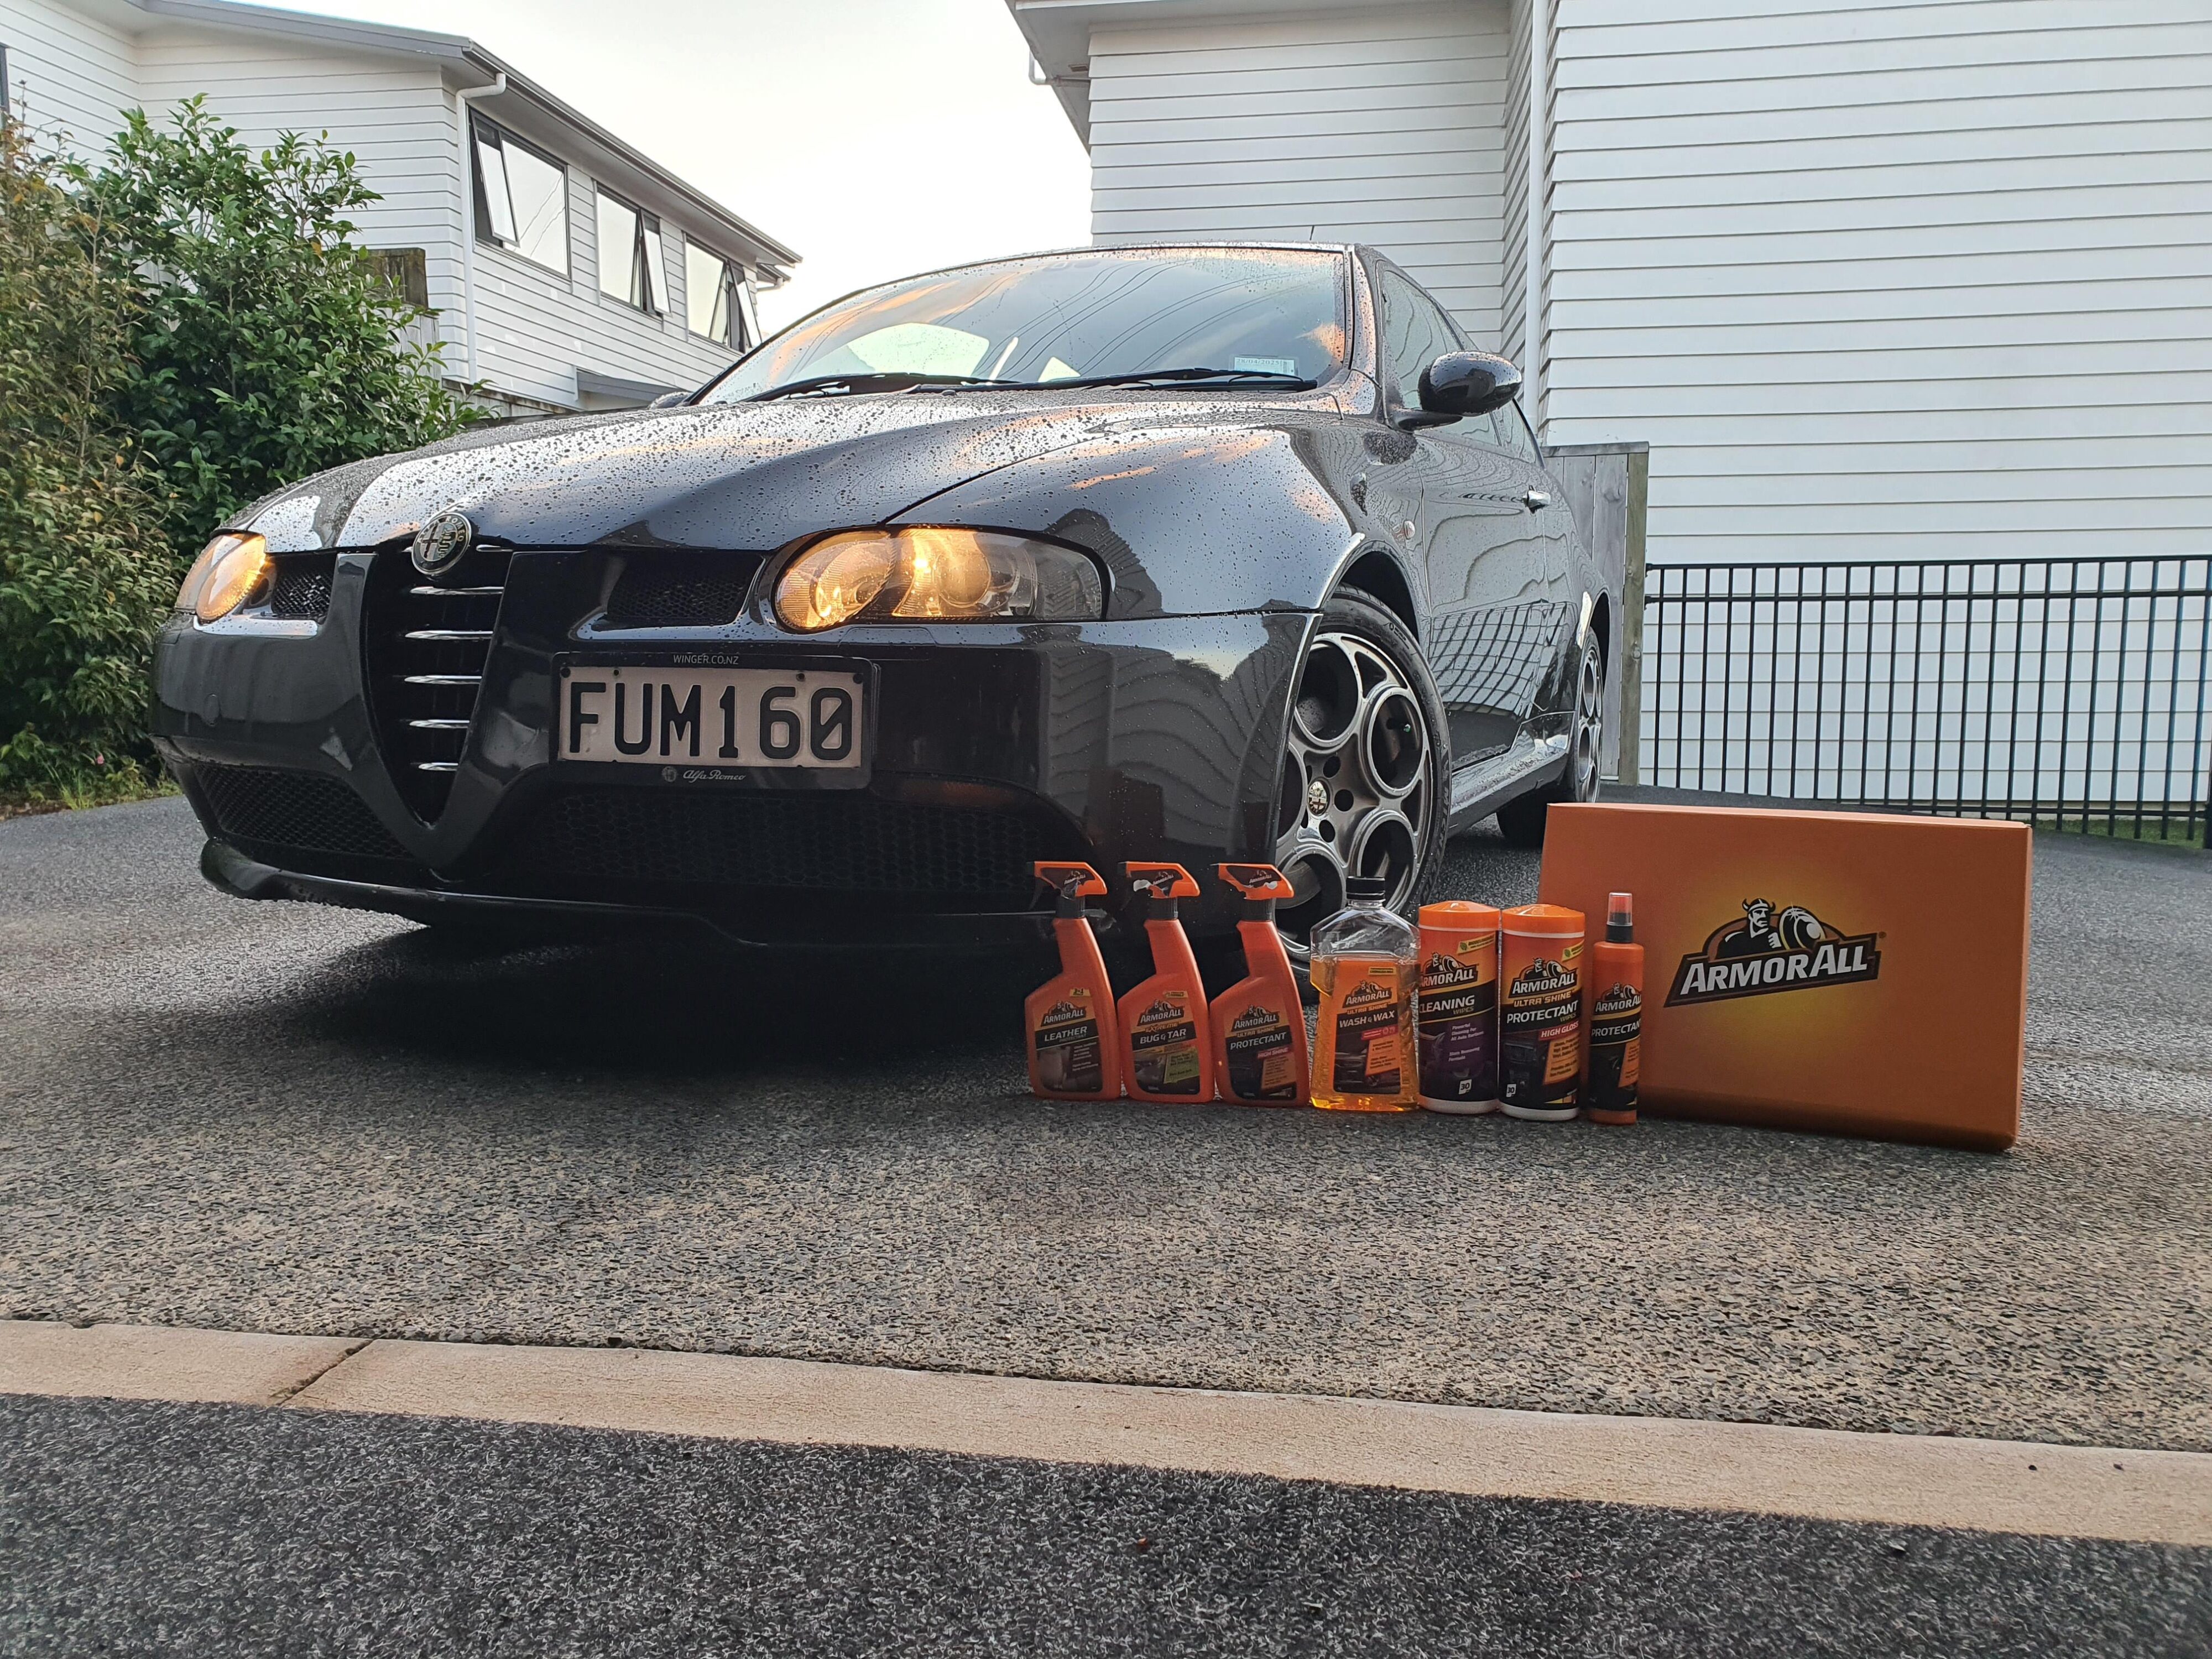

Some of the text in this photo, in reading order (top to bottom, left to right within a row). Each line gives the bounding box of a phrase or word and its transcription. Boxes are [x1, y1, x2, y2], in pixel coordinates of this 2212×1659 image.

[446, 515, 466, 542] ROMEO
[673, 654, 739, 665] WINGER.CO.NZ
[570, 681, 852, 760] FUM160
[683, 769, 747, 783] Alfa Romeo
[1514, 991, 1572, 1008] ULTRA SHINE
[1453, 1005, 1474, 1015] WIPES
[1506, 1000, 1579, 1024] PROTECTANT
[1339, 1016, 1367, 1028] WASH
[1374, 1010, 1395, 1022] WAX
[1591, 1019, 1641, 1036] PROTECTAN
[1044, 1026, 1088, 1042] LEATHER
[1140, 1034, 1160, 1044] BUG
[1167, 1028, 1187, 1039] TAR
[1541, 1020, 1579, 1037] HIGH GLOSS
[1230, 1032, 1287, 1050] PROTECTANT
[1460, 1082, 1470, 1091] 30
